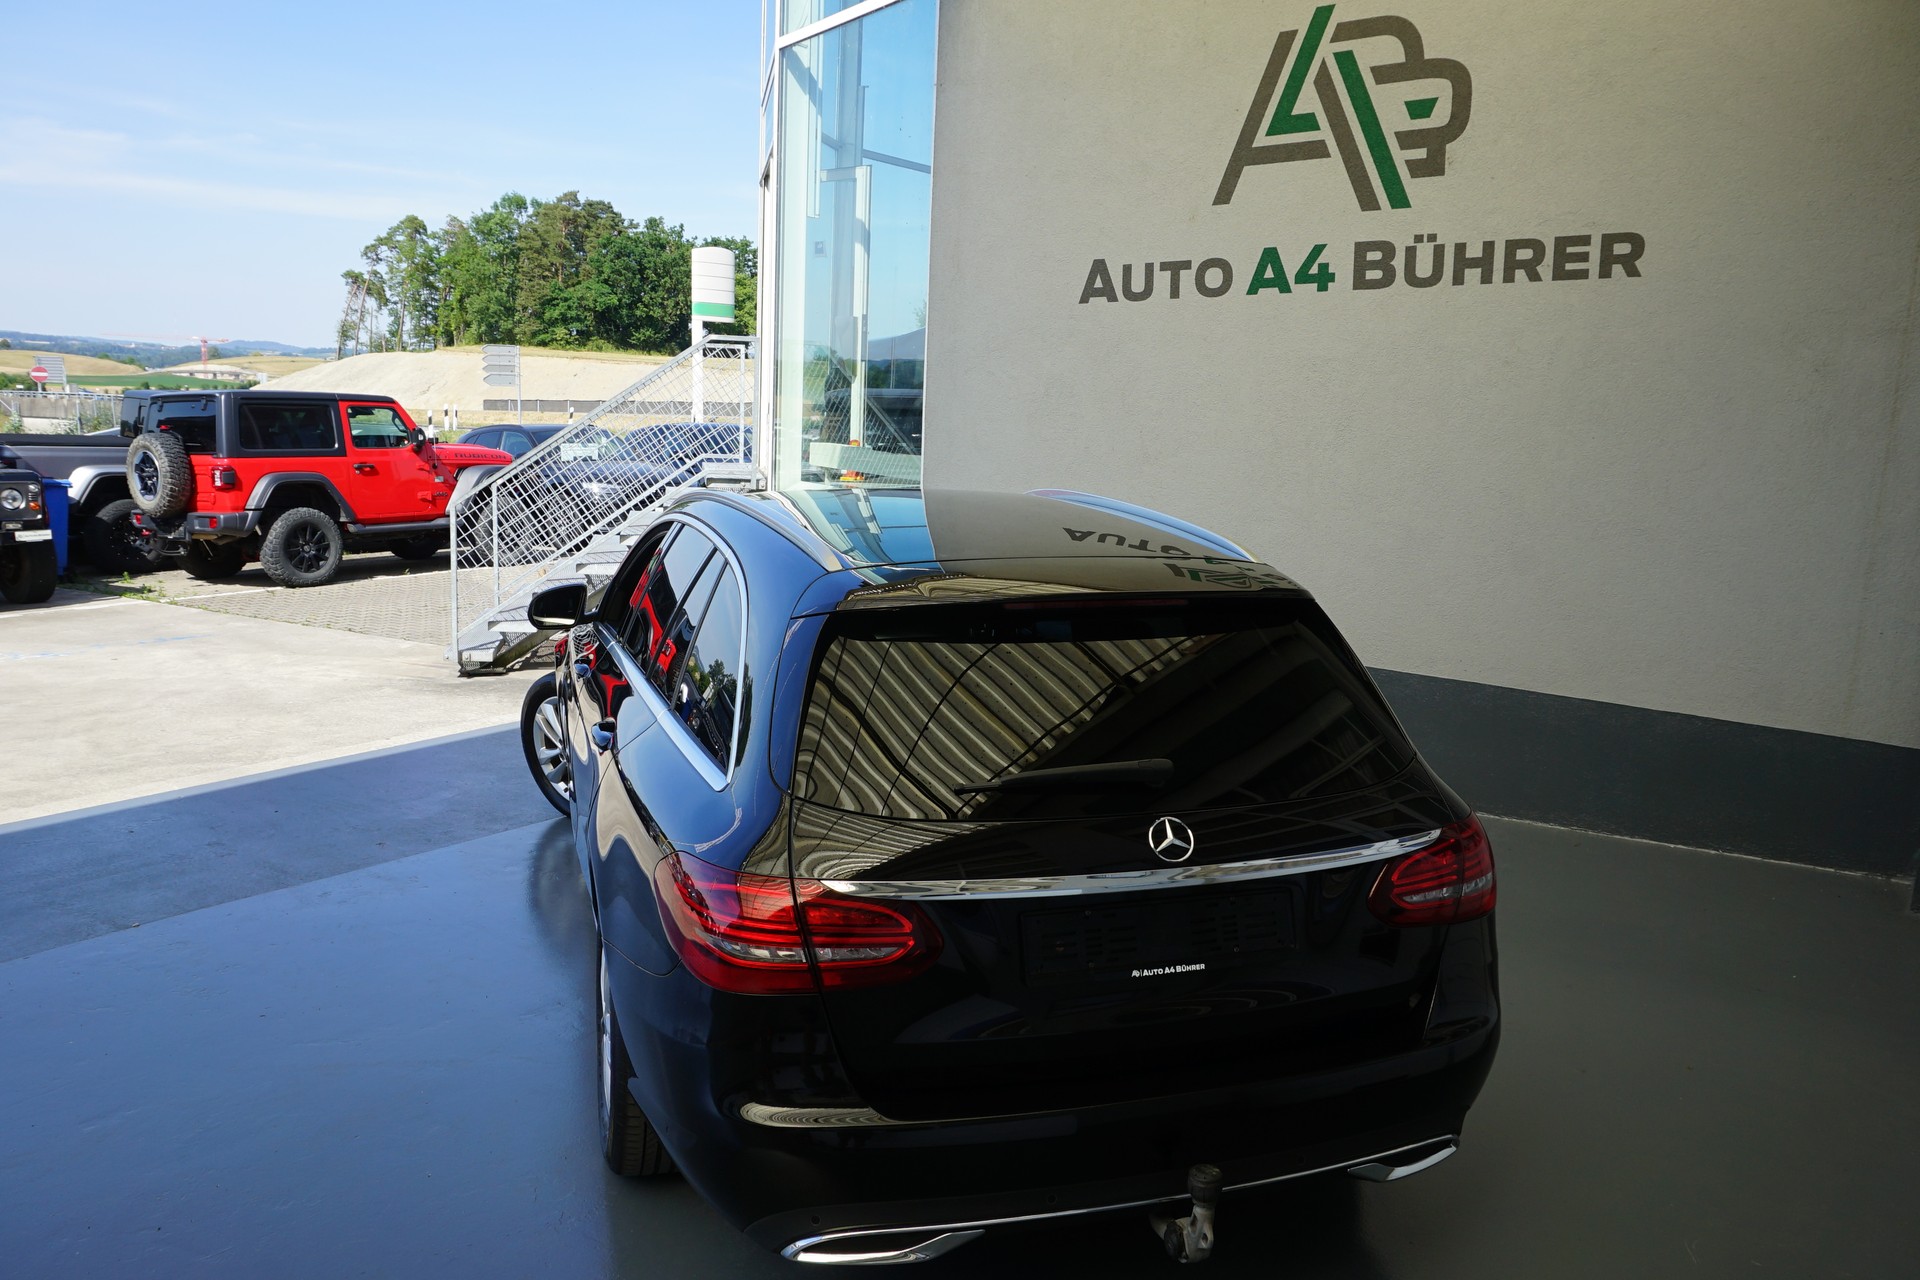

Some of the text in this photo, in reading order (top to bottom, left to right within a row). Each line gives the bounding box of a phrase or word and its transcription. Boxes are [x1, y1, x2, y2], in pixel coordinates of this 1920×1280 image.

[1079, 231, 1646, 304] AUTO A4 BÜHRER
[1143, 968, 1163, 976] AUTO
